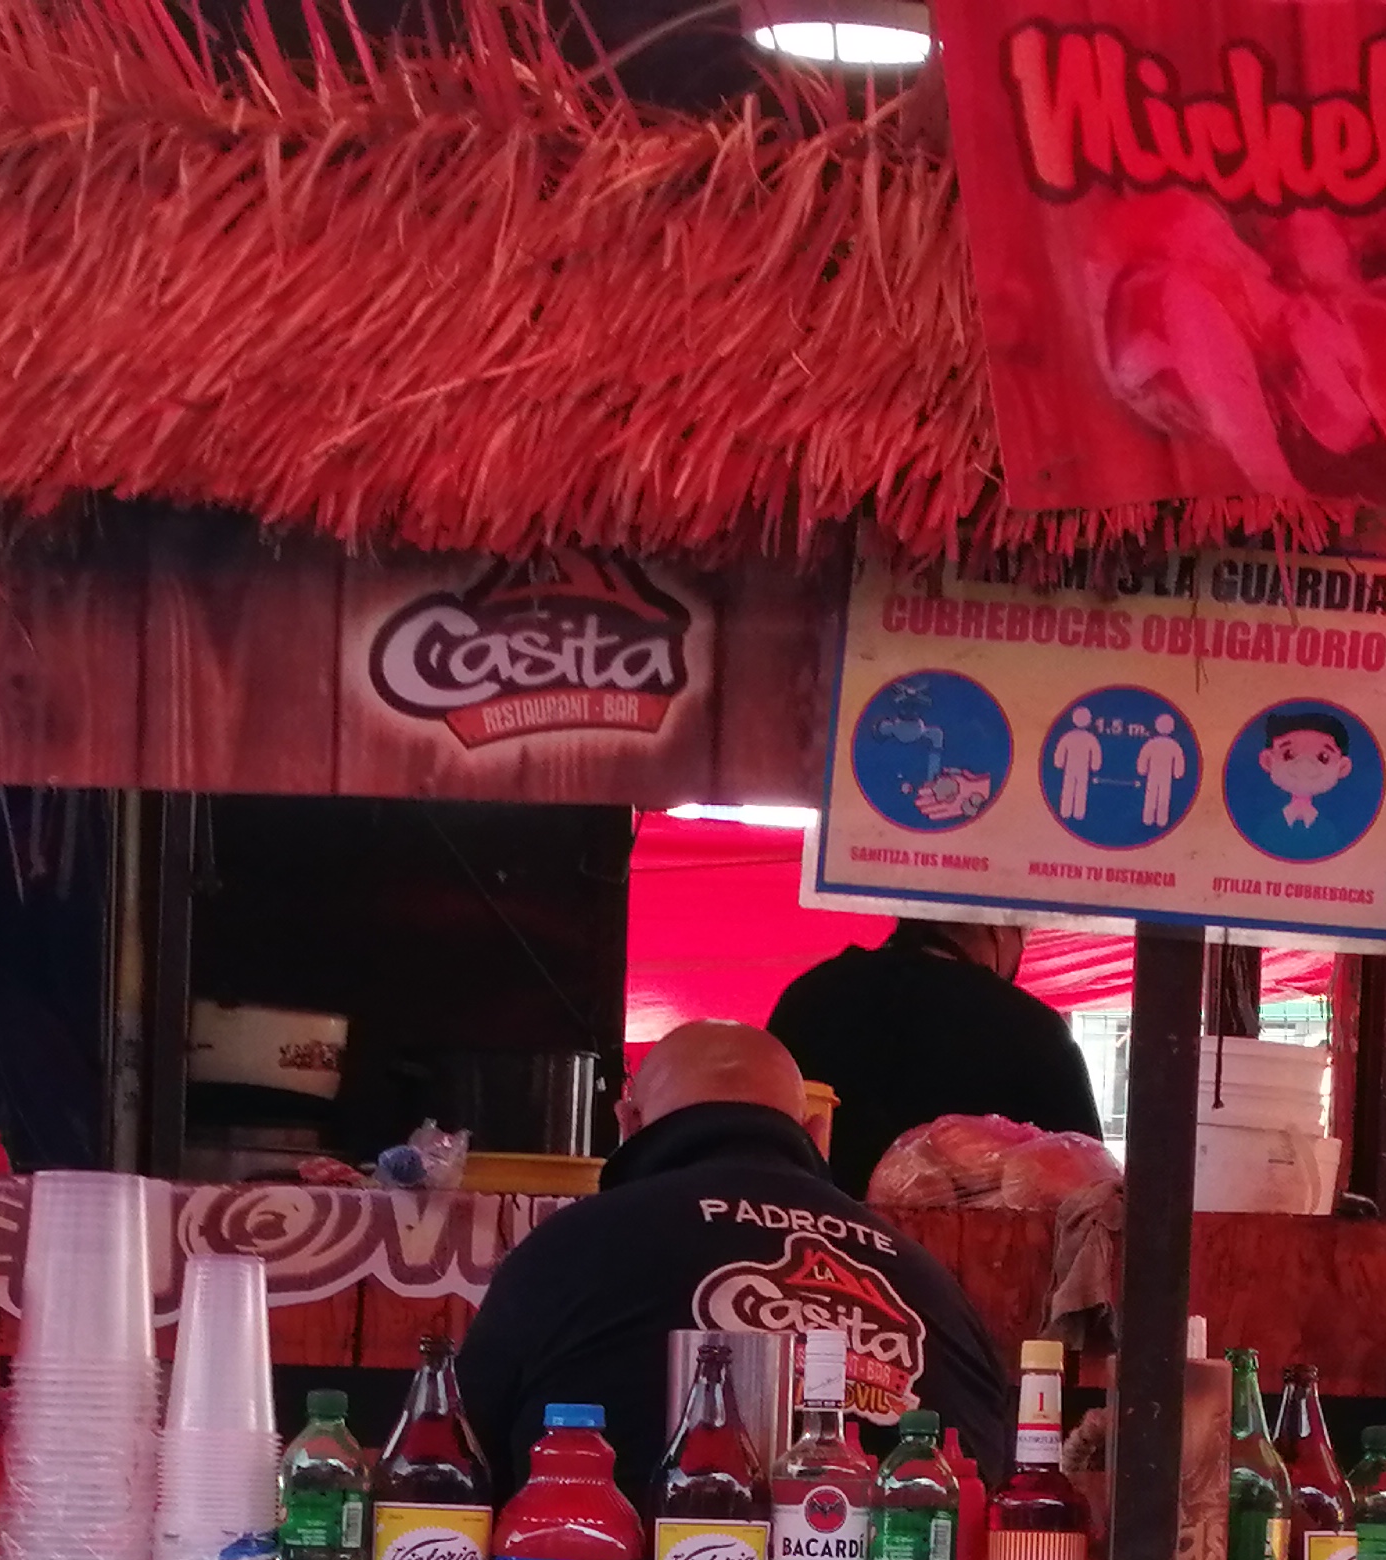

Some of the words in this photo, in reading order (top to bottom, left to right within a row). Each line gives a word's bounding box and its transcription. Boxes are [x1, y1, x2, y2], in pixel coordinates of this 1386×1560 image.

[882, 594, 1132, 650] CUBREBOCAS
[382, 605, 675, 708] Casita
[482, 694, 591, 734] RESTAURANT
[603, 696, 639, 723] BAR
[850, 846, 910, 865] SANITIZA
[913, 852, 938, 867] TUS
[941, 854, 989, 872] MANOS
[1028, 861, 1083, 879] MANTEN
[1086, 867, 1103, 881] TU
[1105, 867, 1176, 888] DISTANCIA
[1213, 876, 1262, 896] UTILIZA
[1265, 881, 1282, 898] TU
[1285, 883, 1375, 905] CUBREBOCAS
[699, 1199, 898, 1257] PADROTE
[813, 1265, 836, 1283] LA
[709, 1274, 913, 1368] Casita
[782, 1534, 865, 1559] BACARDÍ
